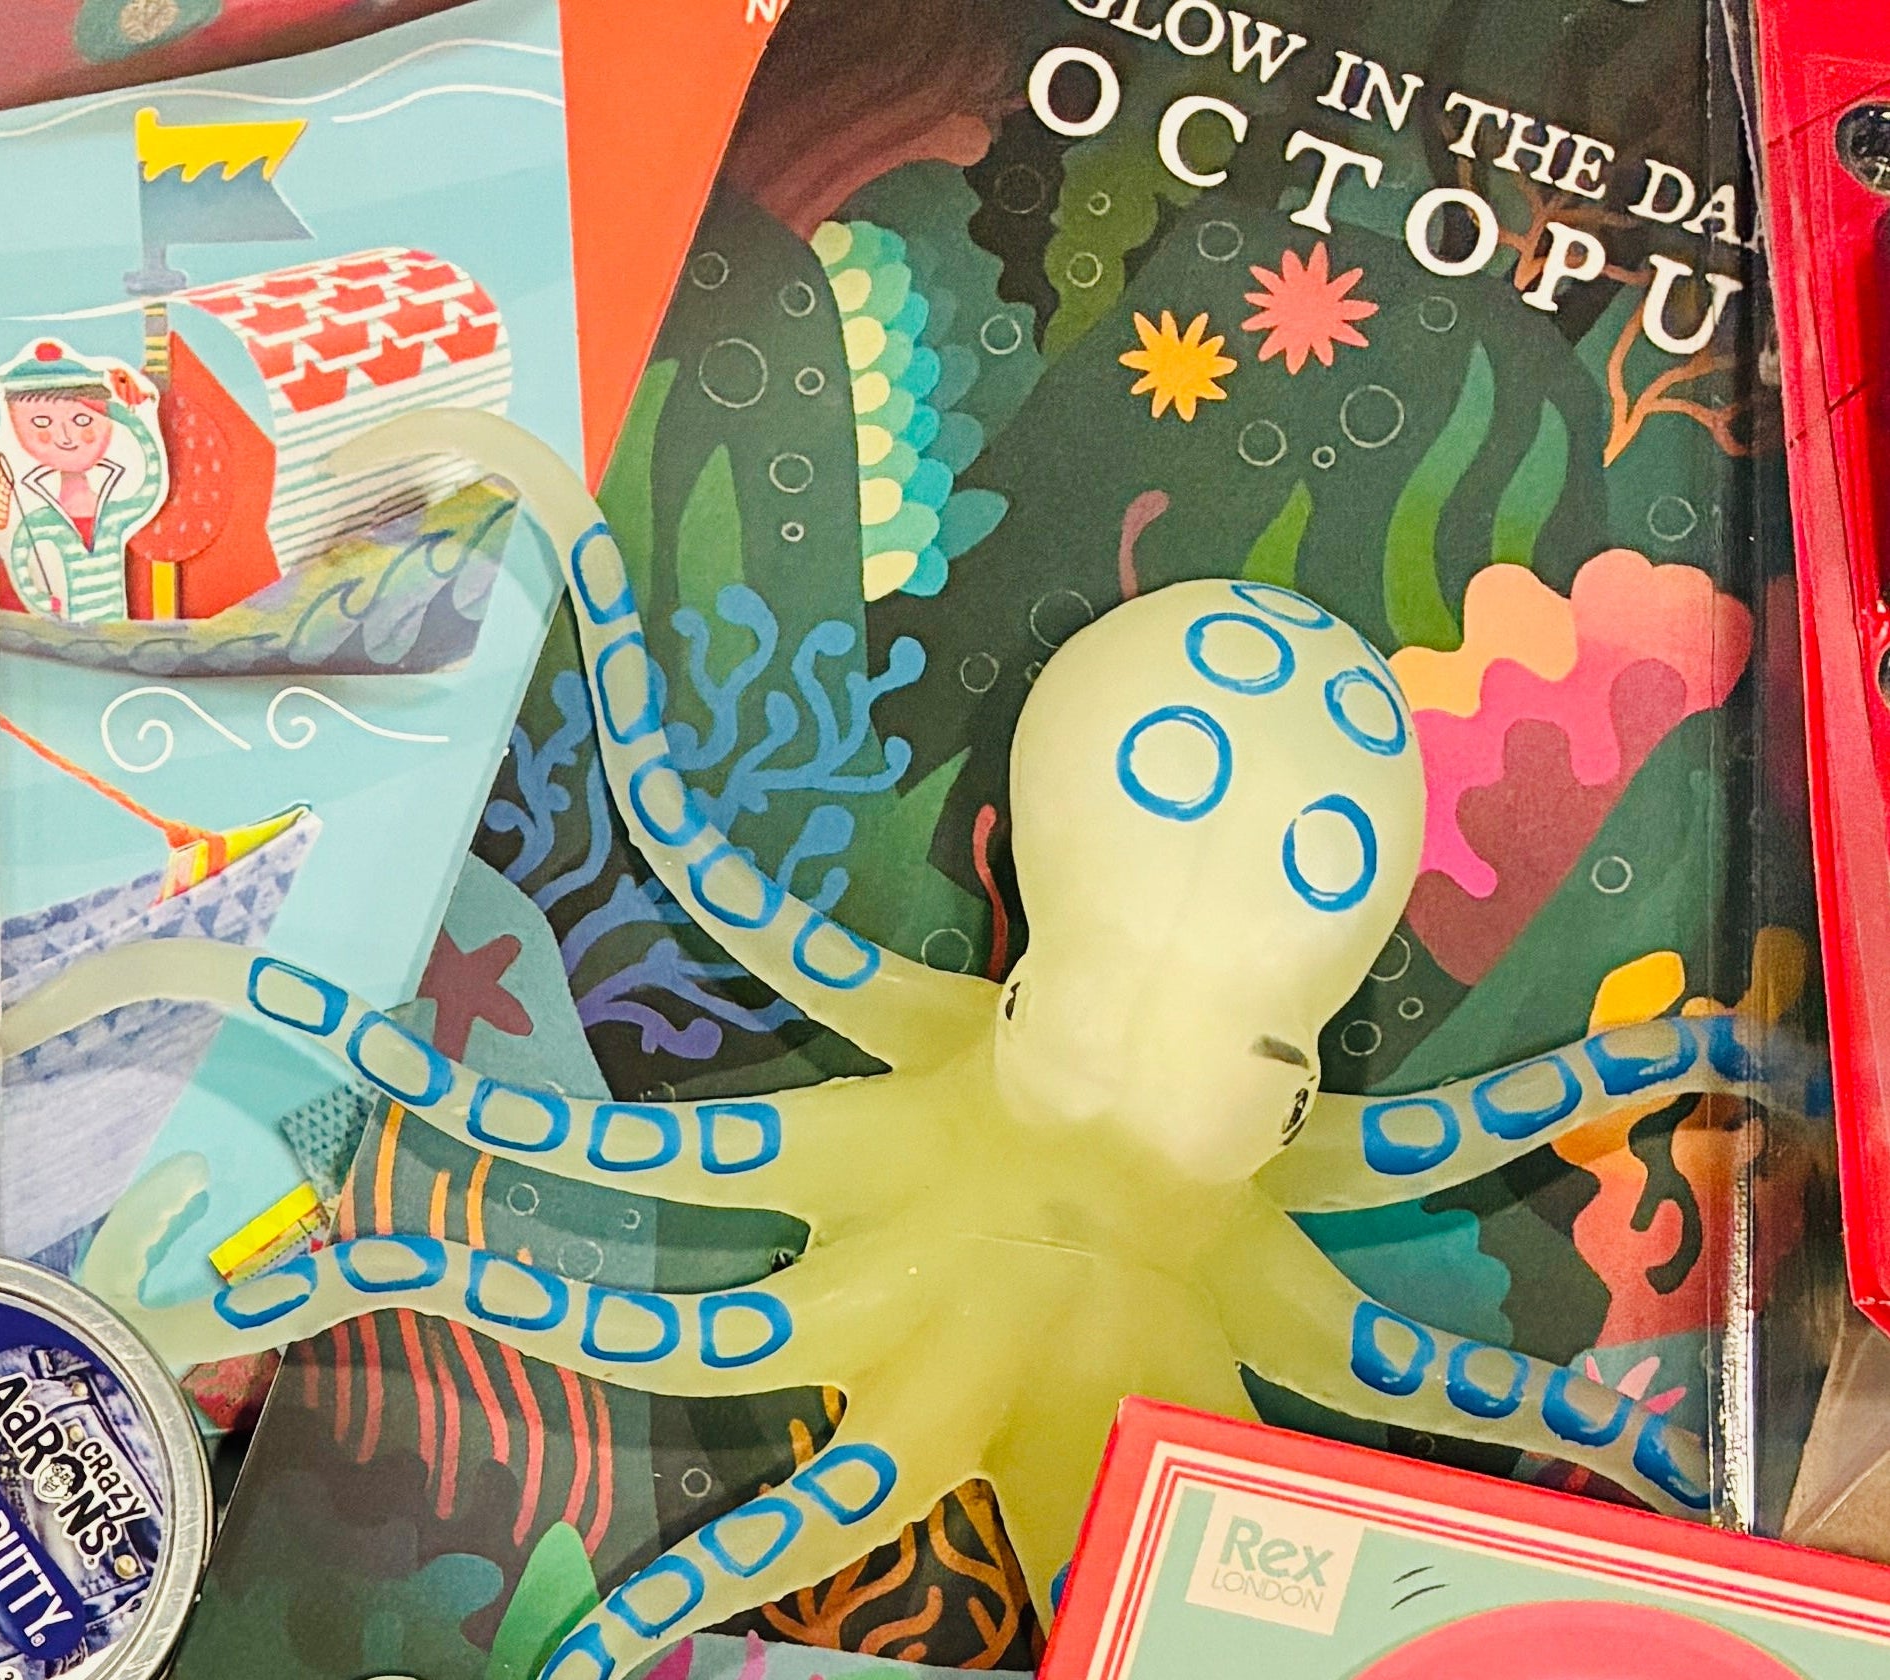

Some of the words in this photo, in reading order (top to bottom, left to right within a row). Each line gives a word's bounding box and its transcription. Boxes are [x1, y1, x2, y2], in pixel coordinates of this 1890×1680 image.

[1318, 51, 1424, 132] IN
[1444, 91, 1615, 201] THE
[1027, 46, 1744, 356] OCTOPU
[1210, 1568, 1325, 1614] LONDON
[1218, 1518, 1336, 1588] Rex
